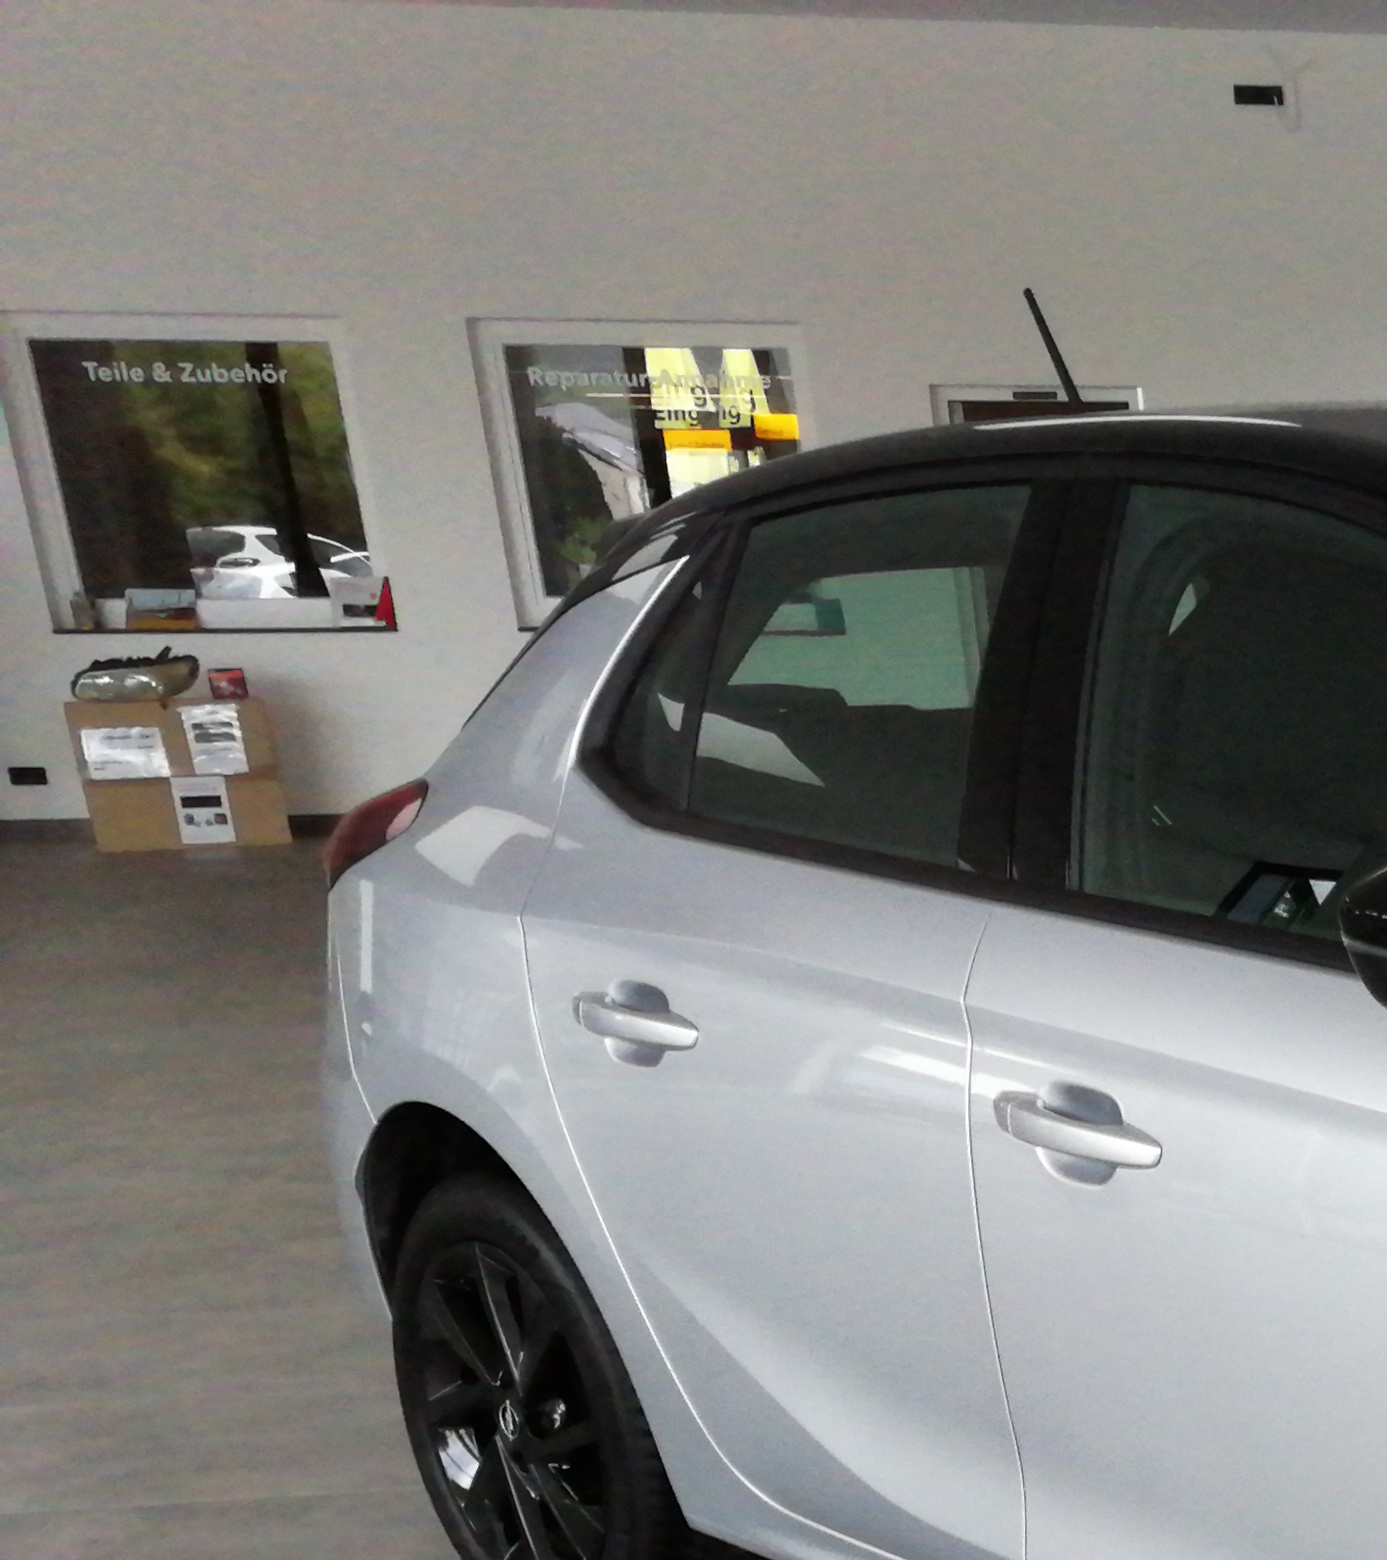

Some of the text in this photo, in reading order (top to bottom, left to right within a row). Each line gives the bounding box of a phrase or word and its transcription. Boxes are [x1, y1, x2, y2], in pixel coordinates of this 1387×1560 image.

[81, 360, 288, 384] Teile & Zubehör
